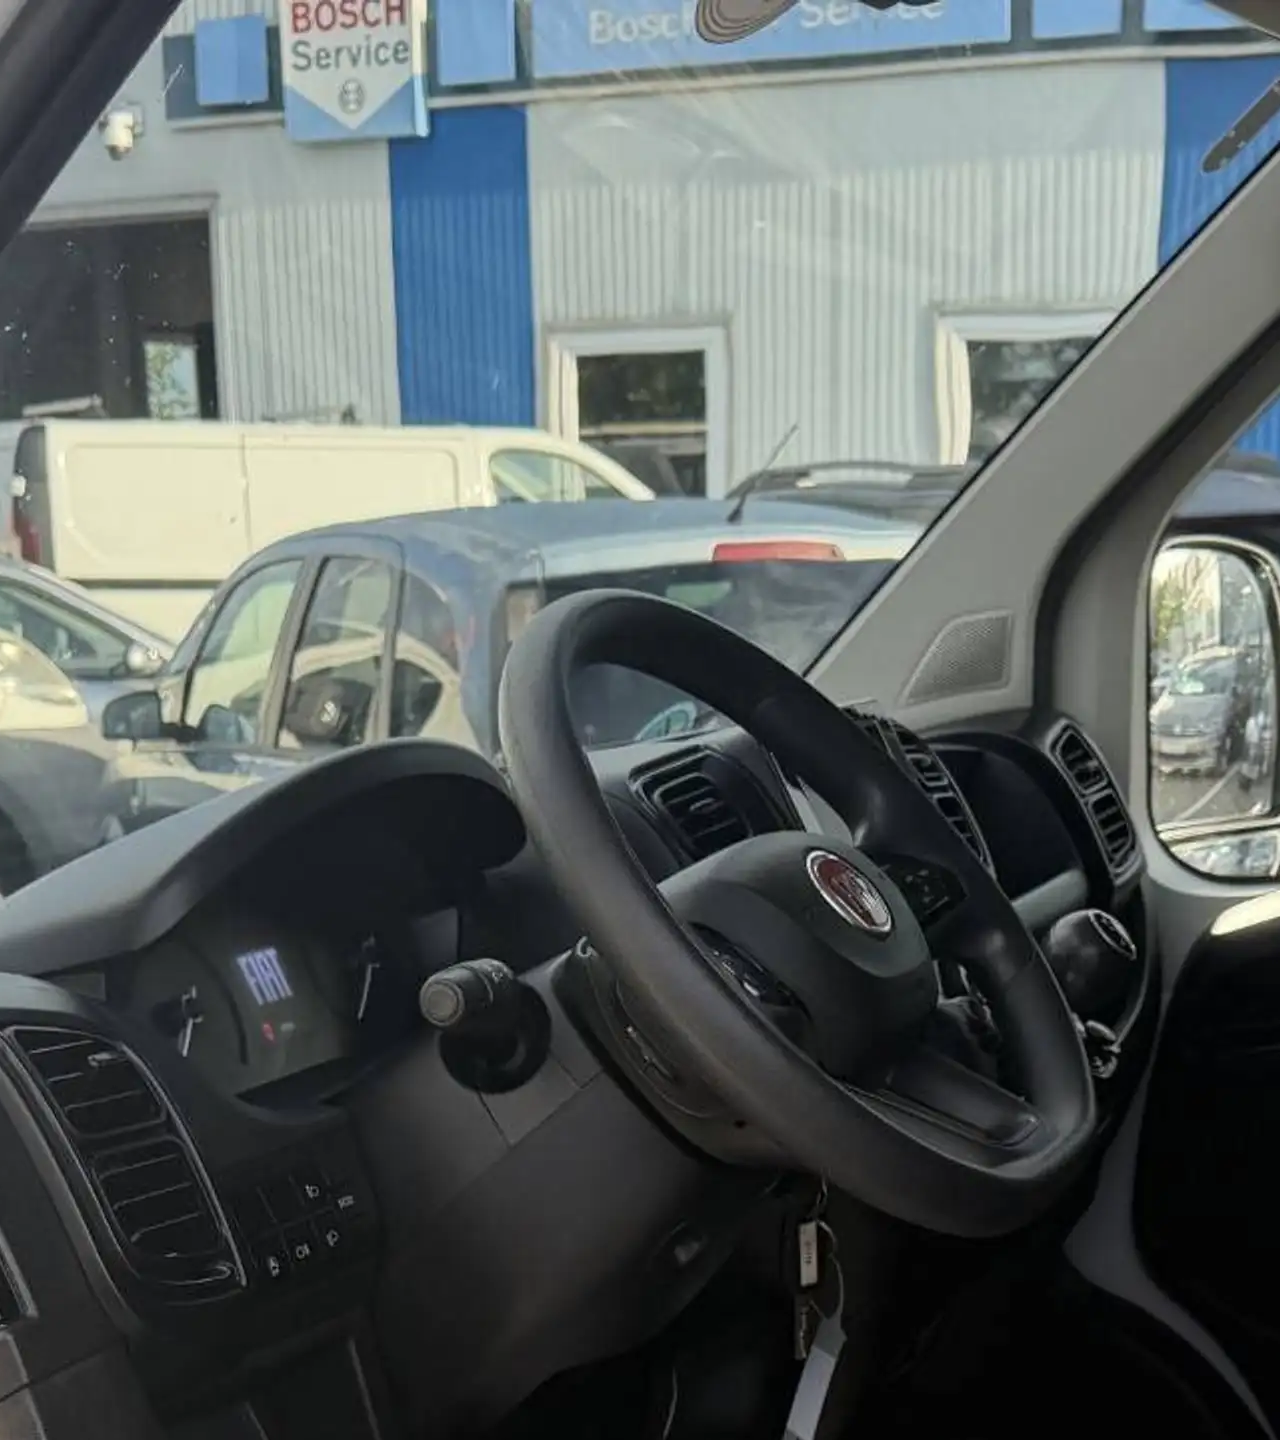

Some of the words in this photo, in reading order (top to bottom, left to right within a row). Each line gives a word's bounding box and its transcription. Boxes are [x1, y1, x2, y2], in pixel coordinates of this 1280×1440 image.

[291, 0, 406, 33] BOSCH
[291, 34, 409, 71] Service
[237, 947, 293, 1005] FIAT
